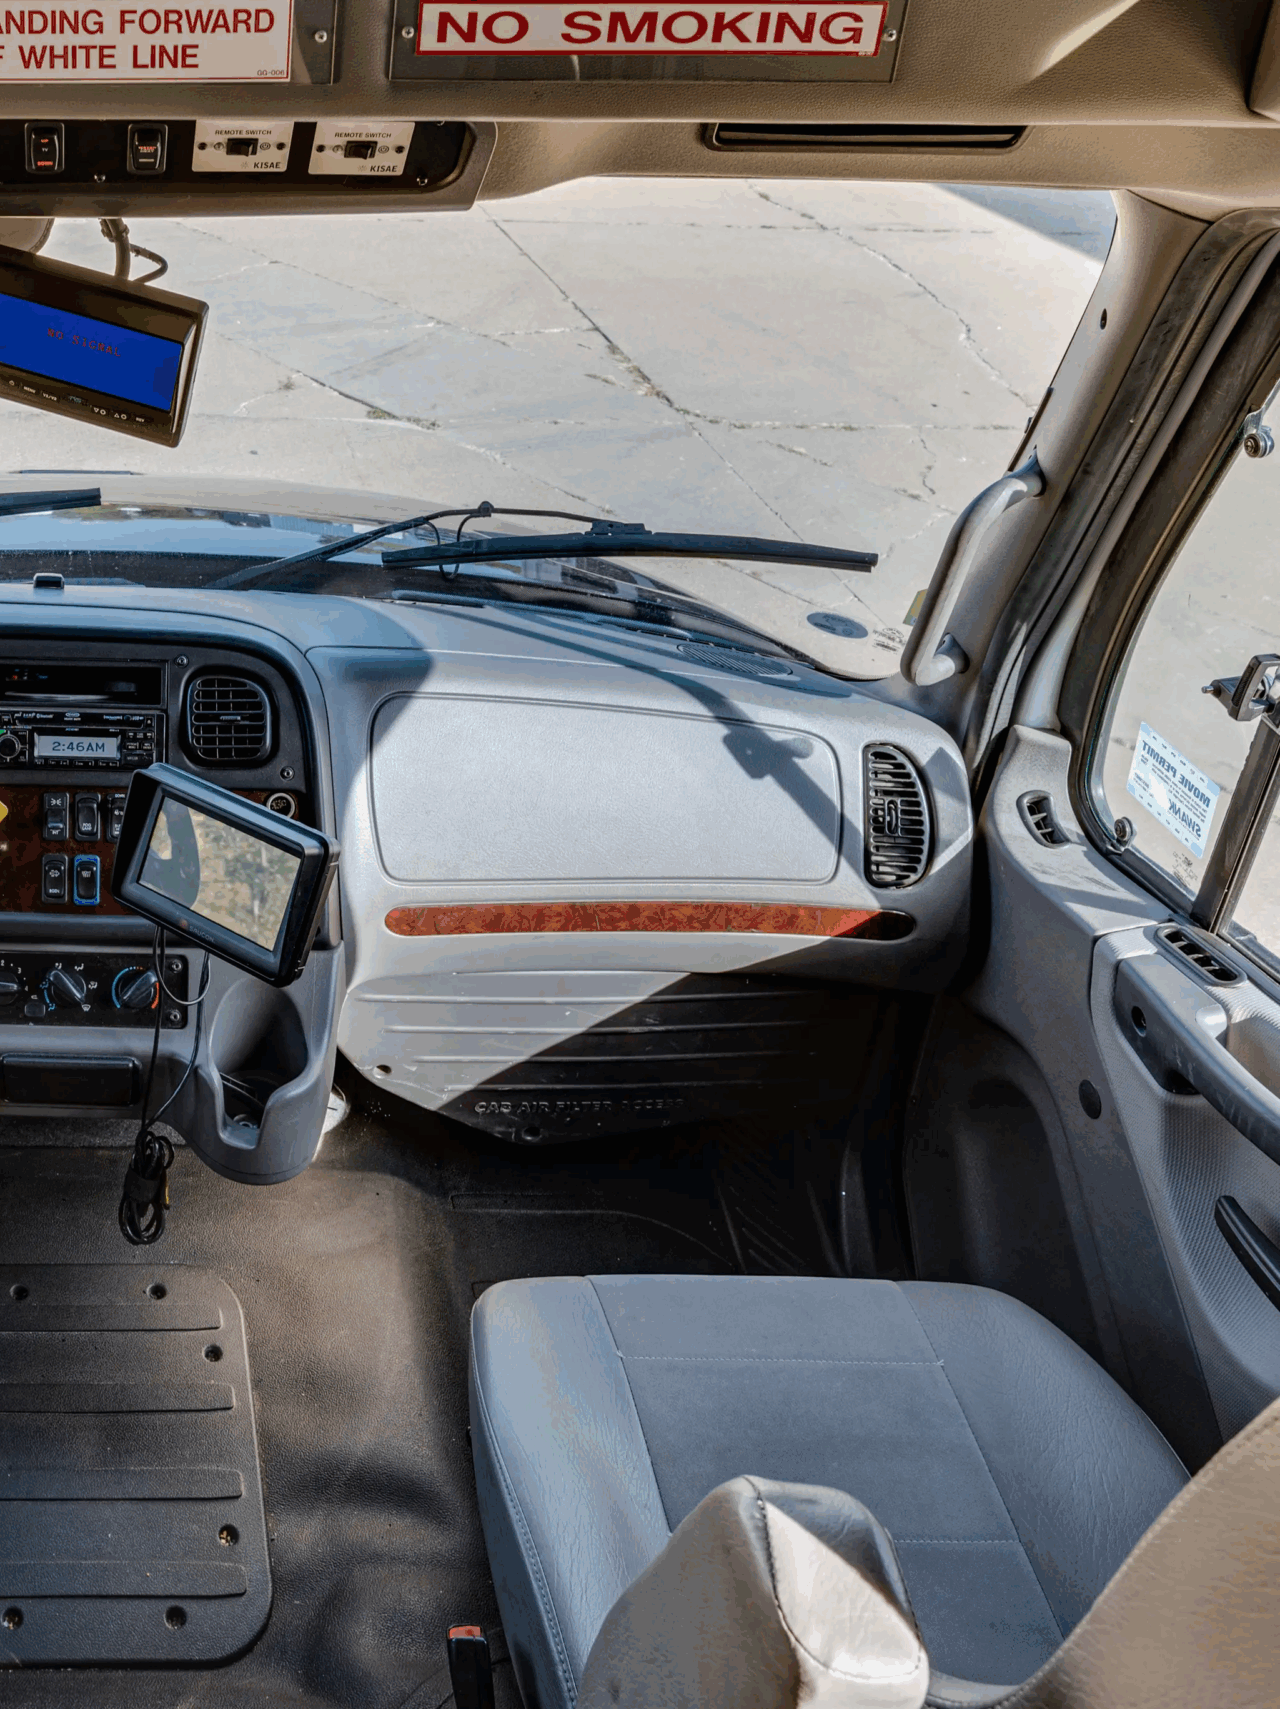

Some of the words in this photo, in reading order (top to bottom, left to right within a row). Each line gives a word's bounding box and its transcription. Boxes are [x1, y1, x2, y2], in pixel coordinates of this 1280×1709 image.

[119, 8, 275, 34] FORWARD
[436, 11, 530, 44] NO
[560, 11, 865, 45] SMOKING
[19, 45, 117, 69] WHITE
[132, 44, 200, 69] LINE
[47, 328, 64, 340] NO
[72, 335, 121, 357] SIGNAL
[52, 742, 105, 752] 2:46AM
[475, 1102, 511, 1113] CAB
[517, 1102, 549, 1113] AIR
